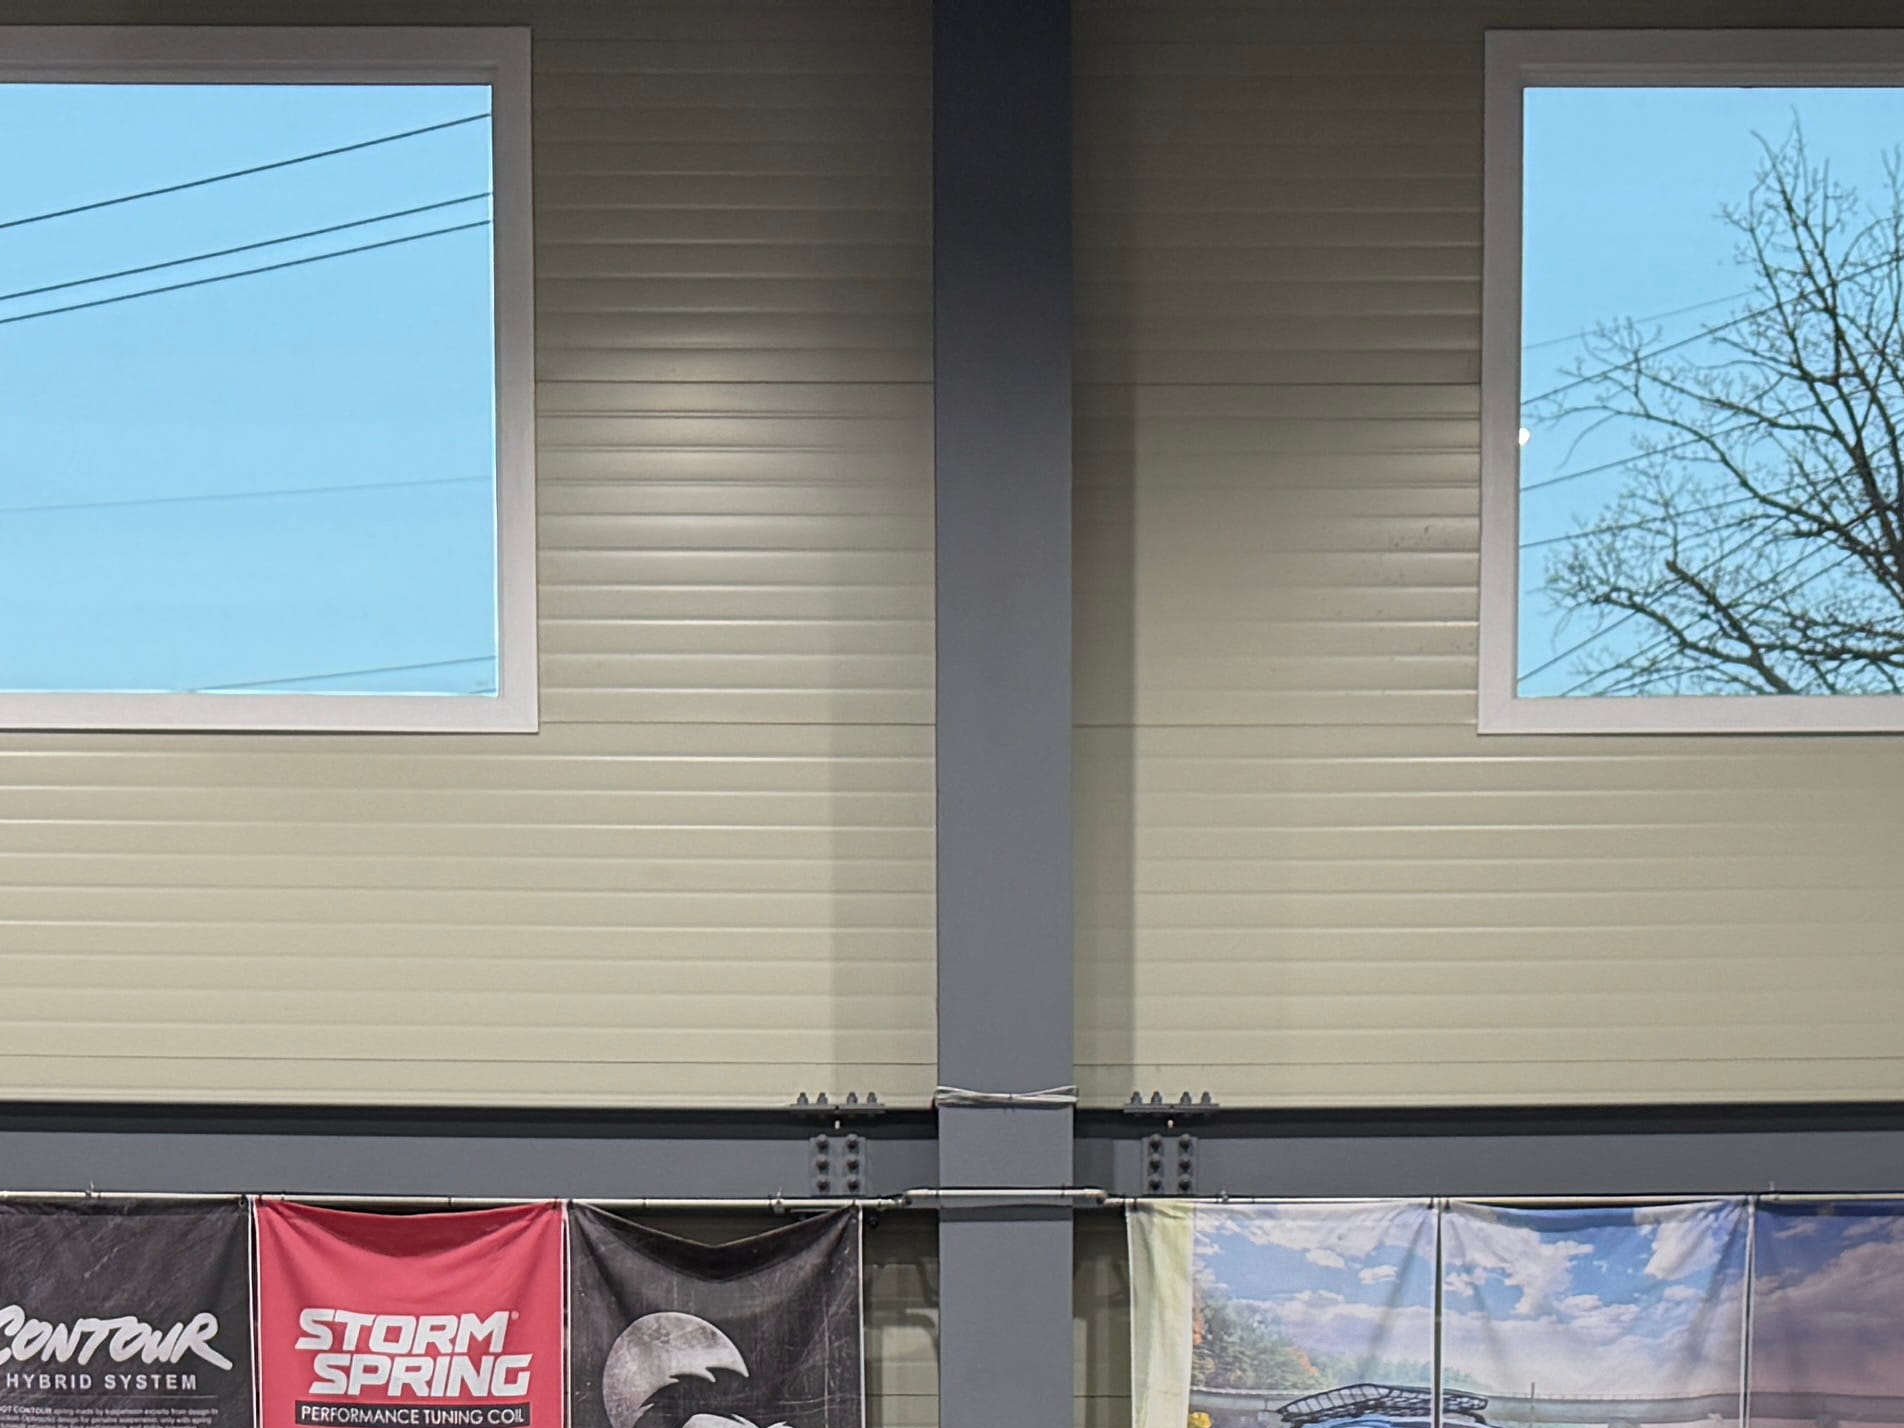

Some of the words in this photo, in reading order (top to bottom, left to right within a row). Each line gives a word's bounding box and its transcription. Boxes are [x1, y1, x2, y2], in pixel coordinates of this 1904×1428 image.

[294, 1308, 510, 1355] STORM
[6, 1373, 92, 1390] HYBRID
[104, 1373, 197, 1390] SYSTEM
[308, 1353, 533, 1398] SPRING
[300, 1405, 420, 1425] PERFORMANCE
[424, 1408, 483, 1425] TUNING
[487, 1407, 524, 1424] COIL
